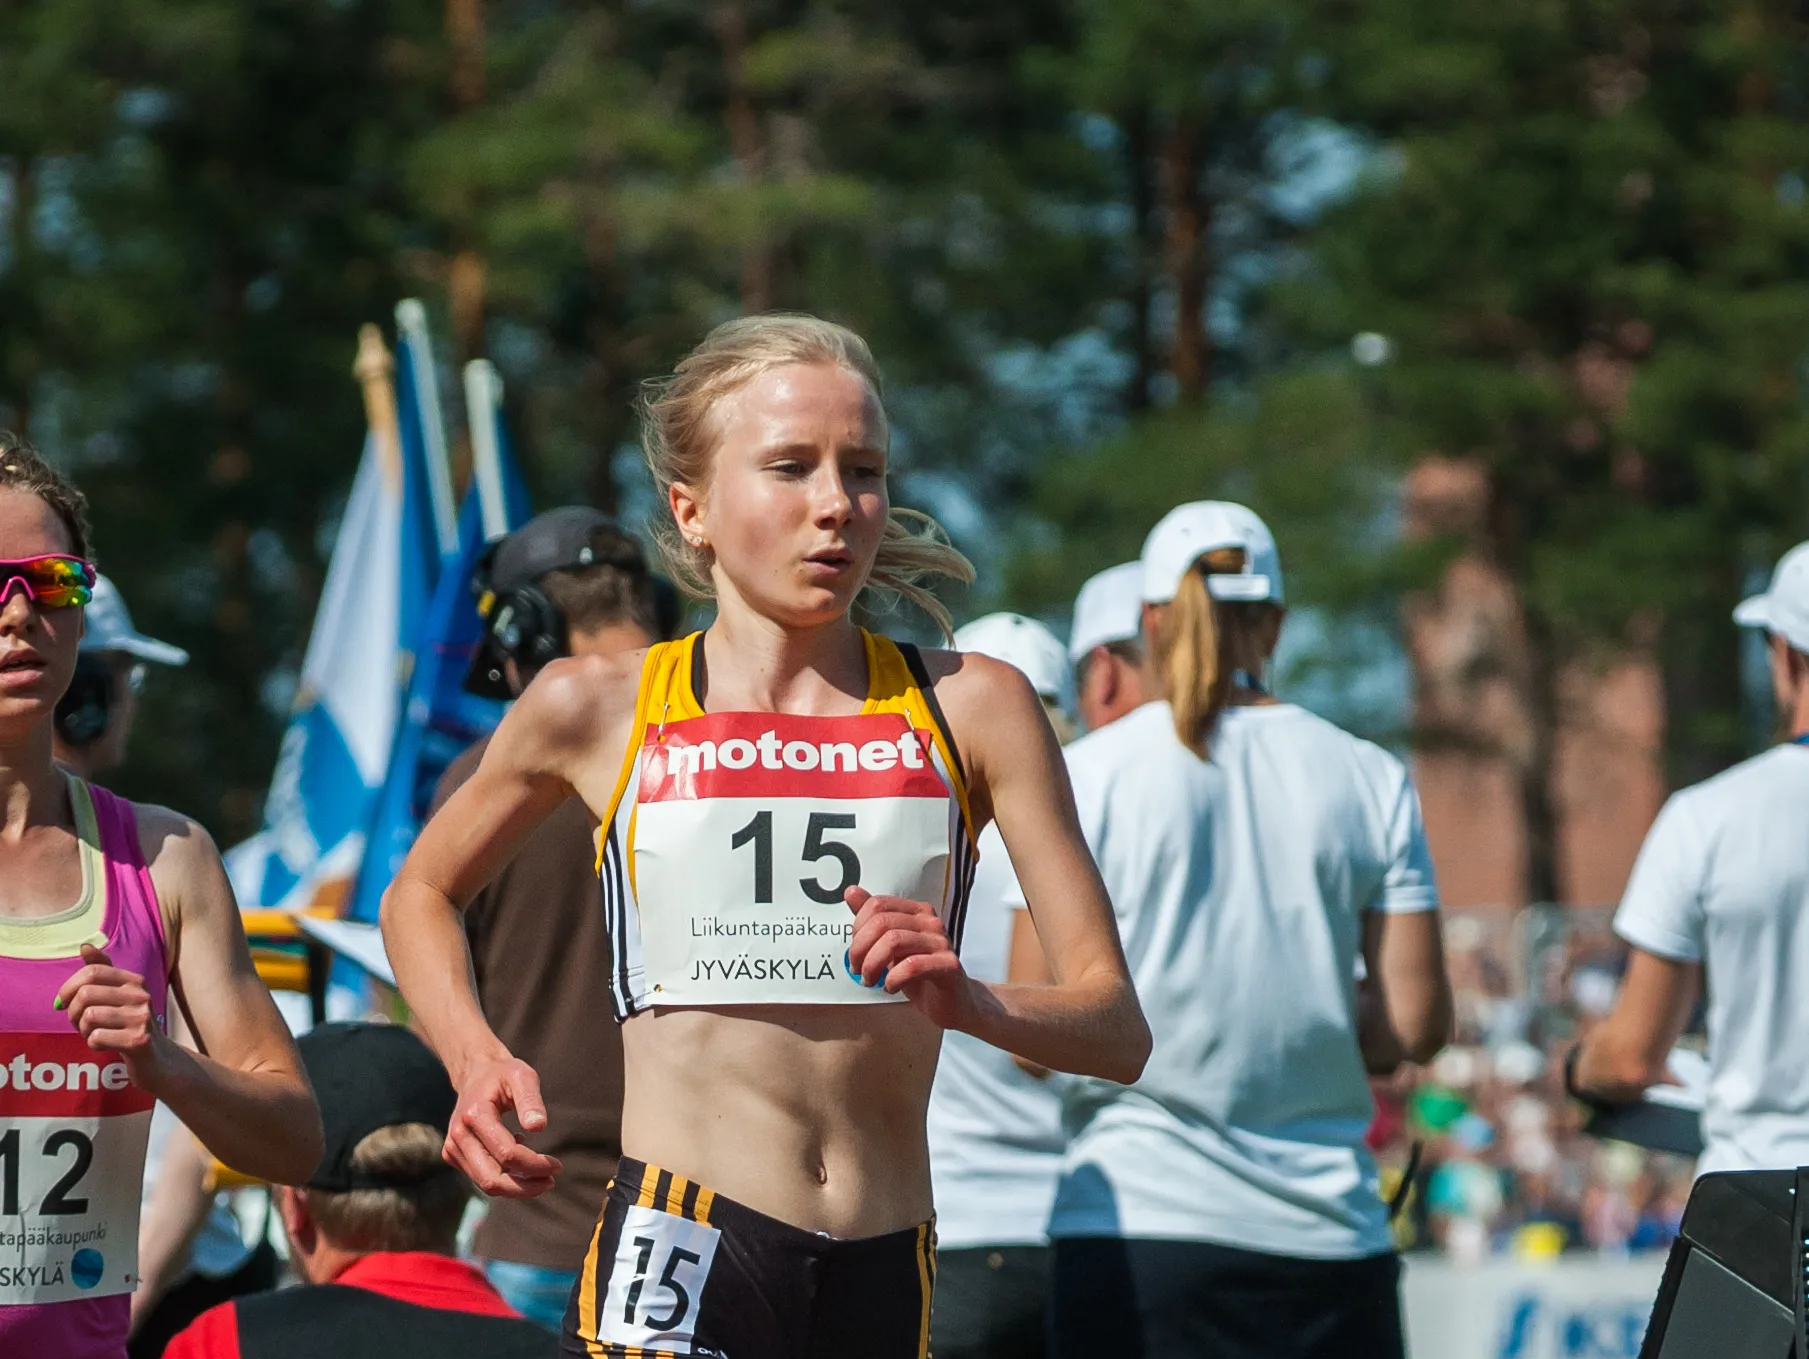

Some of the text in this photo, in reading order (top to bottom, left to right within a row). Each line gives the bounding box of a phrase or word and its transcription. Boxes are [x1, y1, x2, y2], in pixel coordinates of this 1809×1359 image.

[666, 730, 924, 775] motonet
[731, 810, 861, 904] 15
[691, 916, 853, 943] Liikuntapääkaup
[691, 953, 836, 980] JYVÄSKYLÄ
[0, 1053, 129, 1091] tone
[0, 1129, 94, 1215] 12
[0, 1261, 65, 1287] SKYLÄ
[623, 1236, 700, 1331] 15
